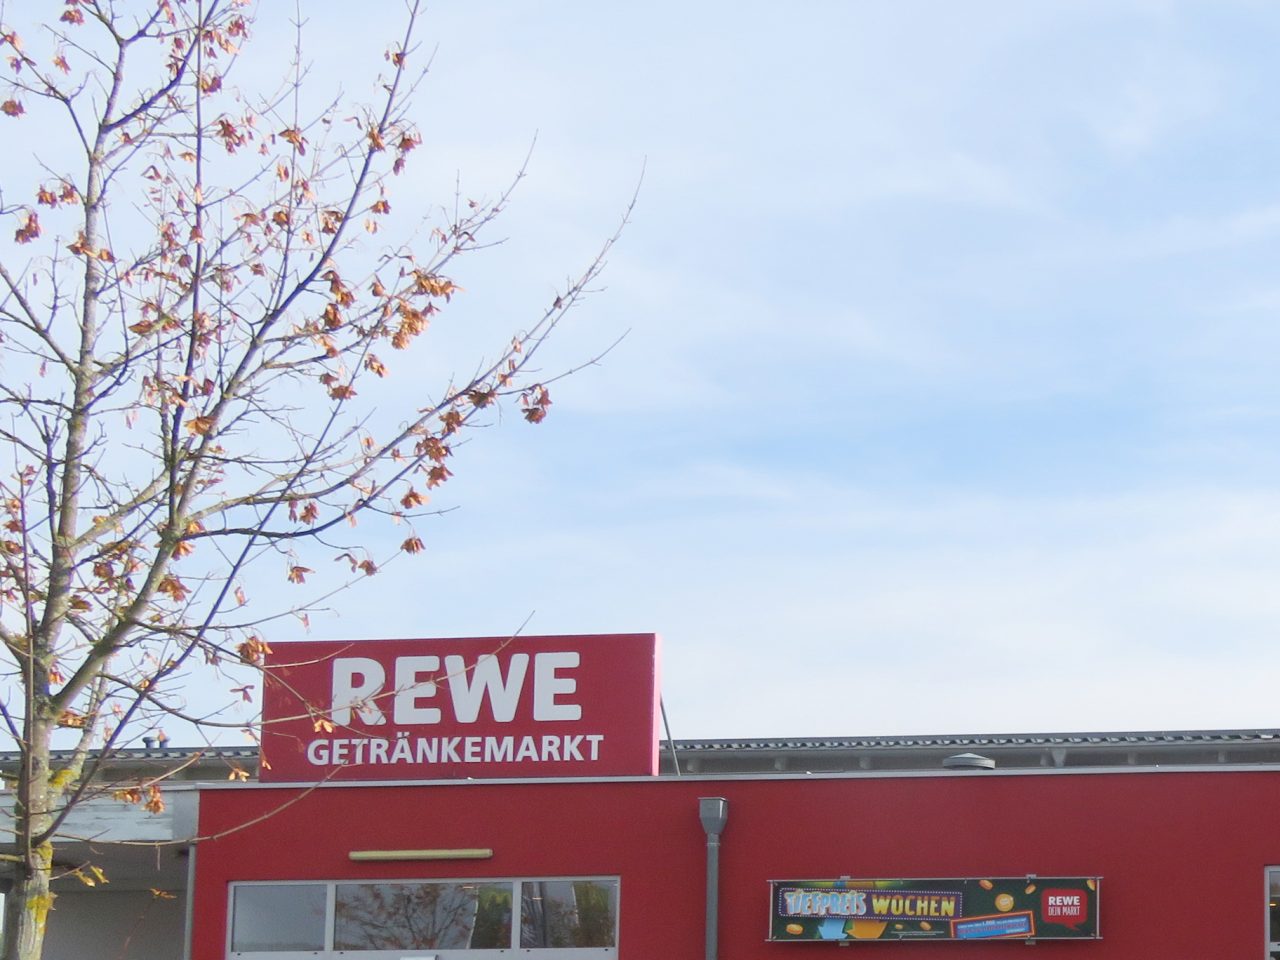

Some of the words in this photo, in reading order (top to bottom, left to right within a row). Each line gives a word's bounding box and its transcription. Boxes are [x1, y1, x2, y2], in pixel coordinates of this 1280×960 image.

[331, 652, 582, 726] REWE
[308, 732, 604, 765] GETRÄNKEMARKT
[785, 889, 867, 915] TIEFPREIS
[871, 895, 956, 917] WOCHEN
[1048, 896, 1080, 905] REWE
[1048, 906, 1061, 916] DEIN
[1062, 906, 1080, 915] MARKT
